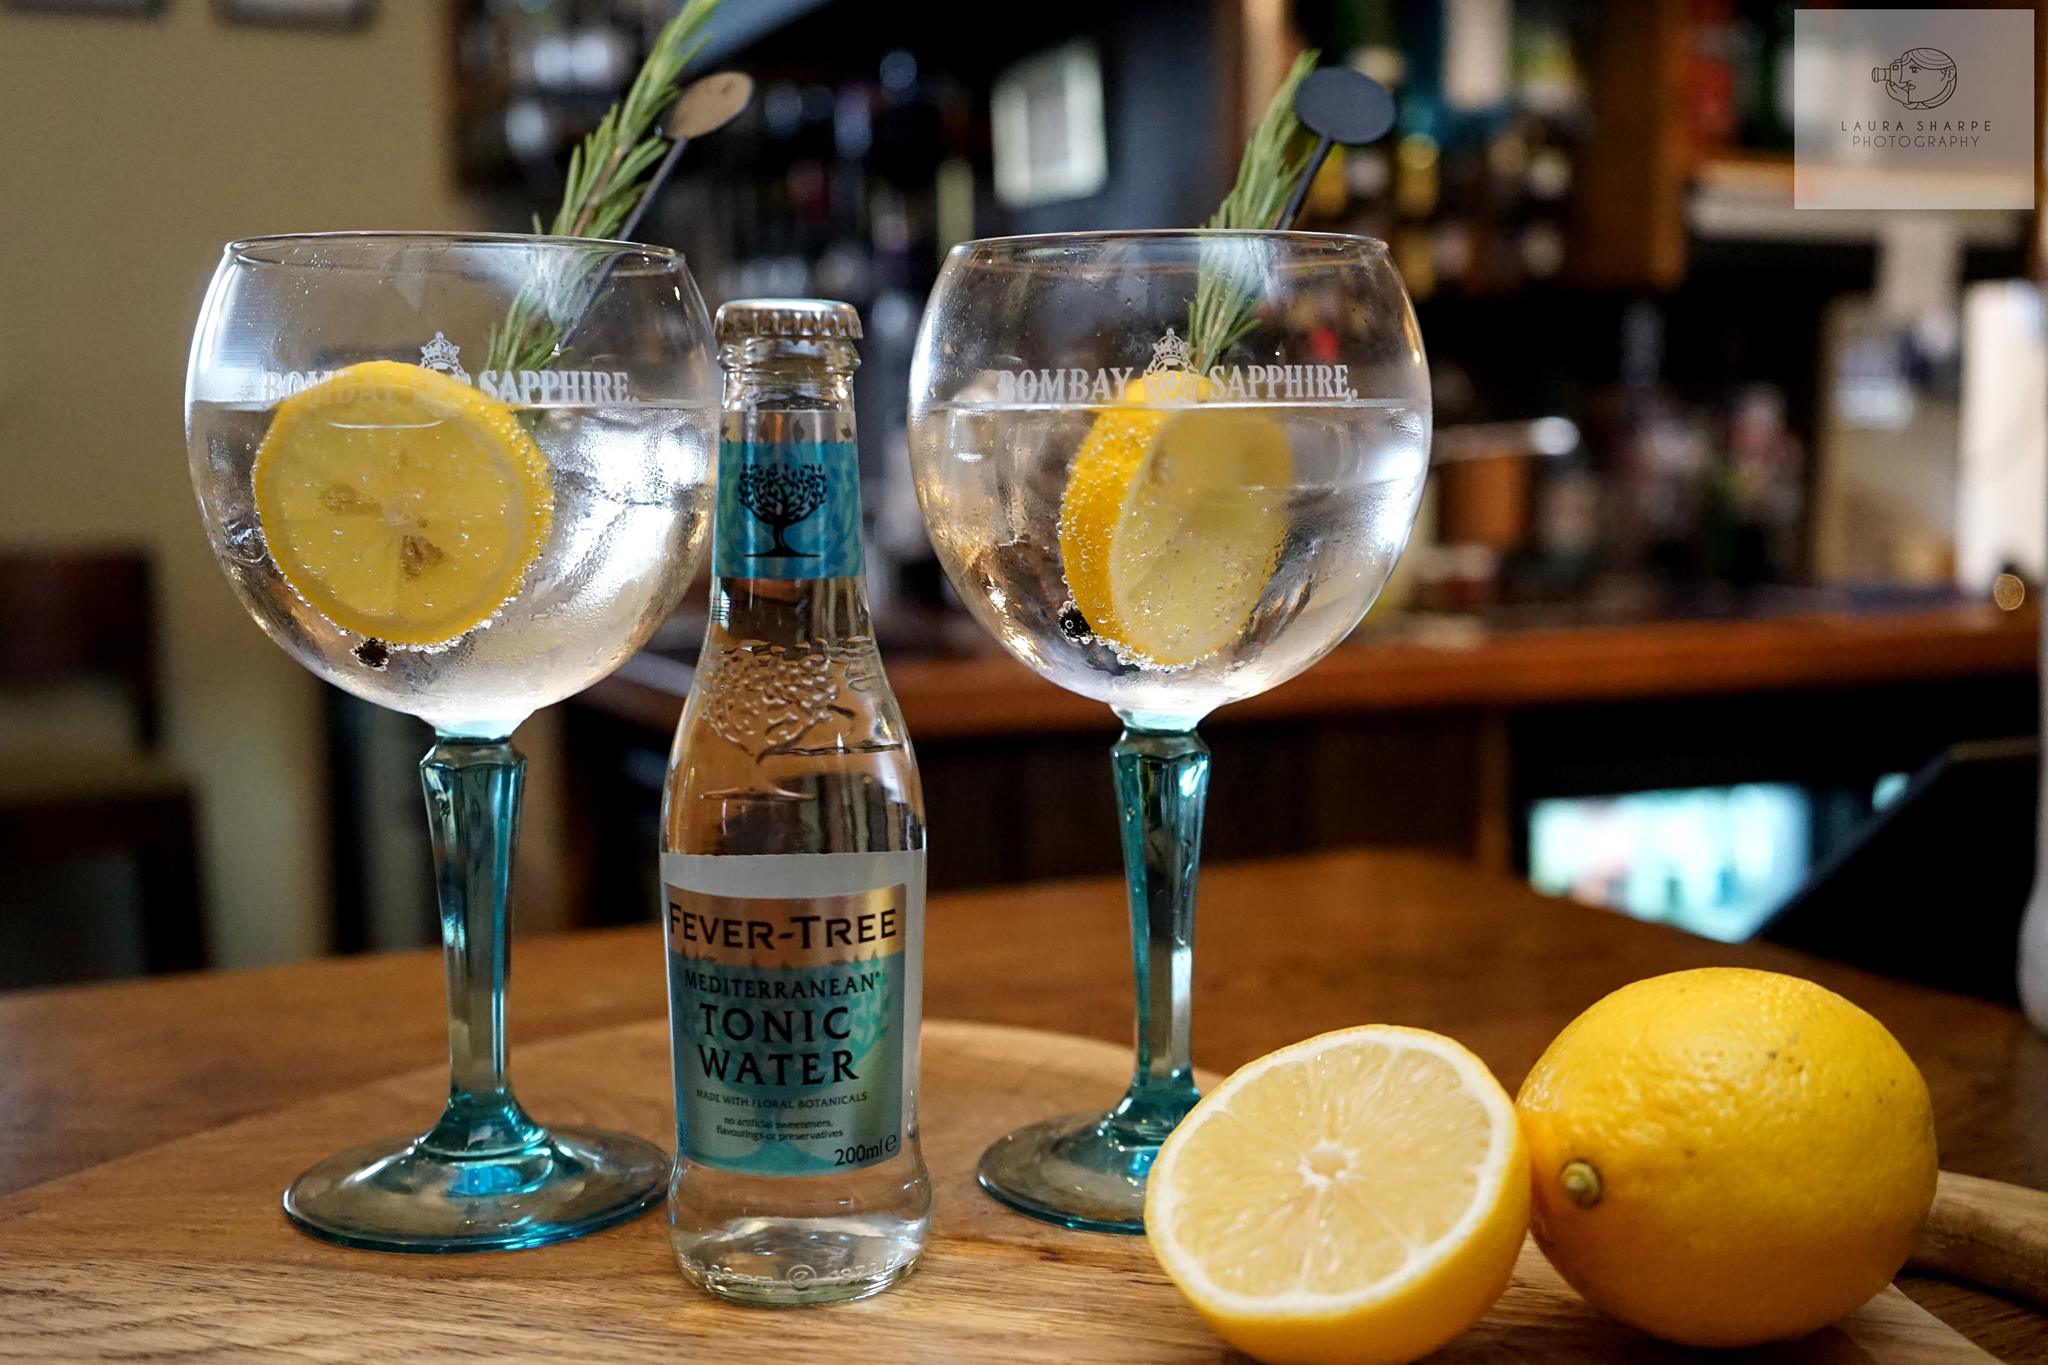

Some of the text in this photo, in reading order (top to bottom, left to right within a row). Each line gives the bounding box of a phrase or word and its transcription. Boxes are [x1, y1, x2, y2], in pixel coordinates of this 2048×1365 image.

[997, 367, 1133, 401] BOMBAY
[669, 901, 897, 950] FEVER-TREE
[700, 1003, 852, 1043] TONIC
[698, 1043, 859, 1086] WATER
[696, 1089, 869, 1110] MADE WITH FLORAL BOTANICALS
[716, 1125, 764, 1142] flavourings
[778, 1129, 844, 1142] preservatives
[724, 1116, 735, 1126] no
[737, 1118, 773, 1129] artificial
